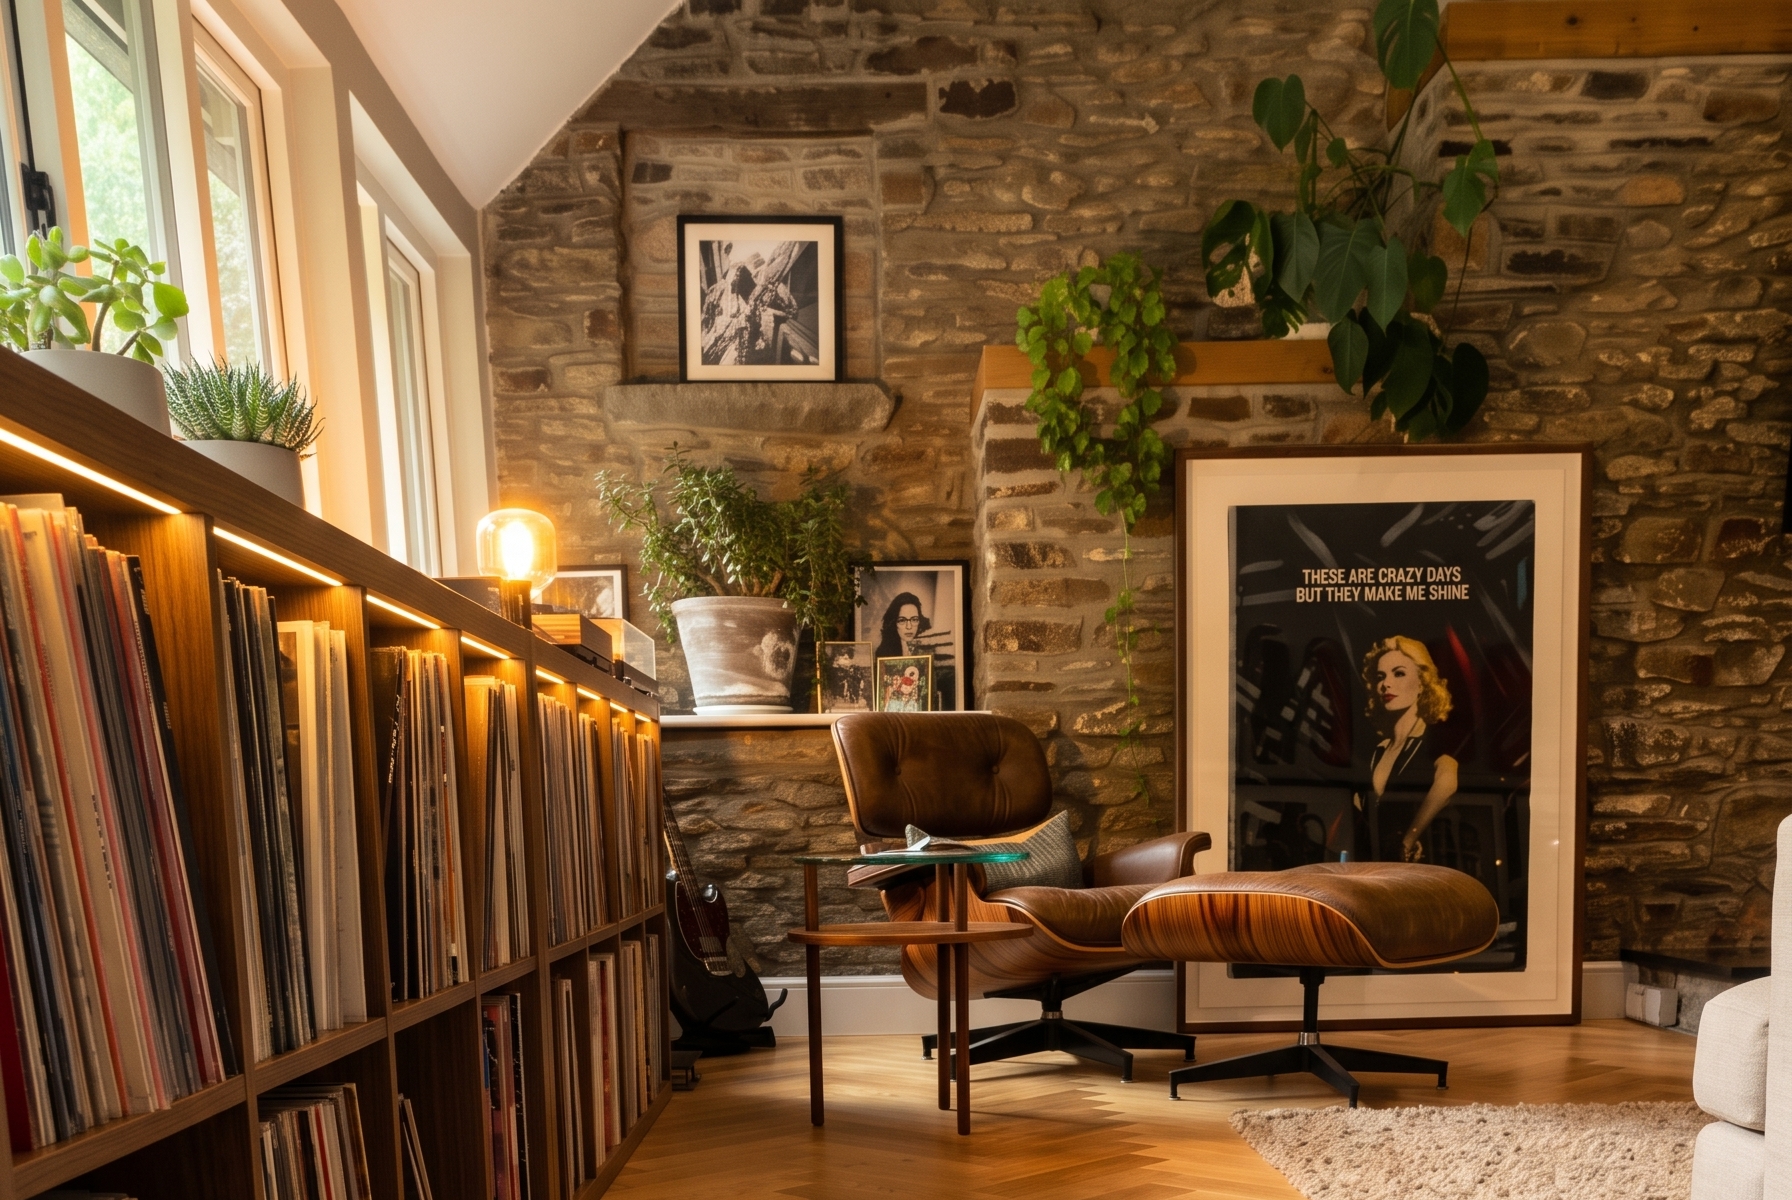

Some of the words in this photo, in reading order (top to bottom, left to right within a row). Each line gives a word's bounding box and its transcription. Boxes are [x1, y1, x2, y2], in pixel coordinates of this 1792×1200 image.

[1302, 568, 1346, 584] THESE
[1348, 568, 1375, 584] ARE
[1378, 567, 1423, 583] CRAZY
[1427, 566, 1461, 582] DAYS
[1296, 587, 1323, 602] BUT
[1326, 587, 1361, 602] THEY
[1364, 586, 1402, 601] MAKE
[1406, 585, 1426, 601] ME
[1429, 584, 1469, 600] SHINE
